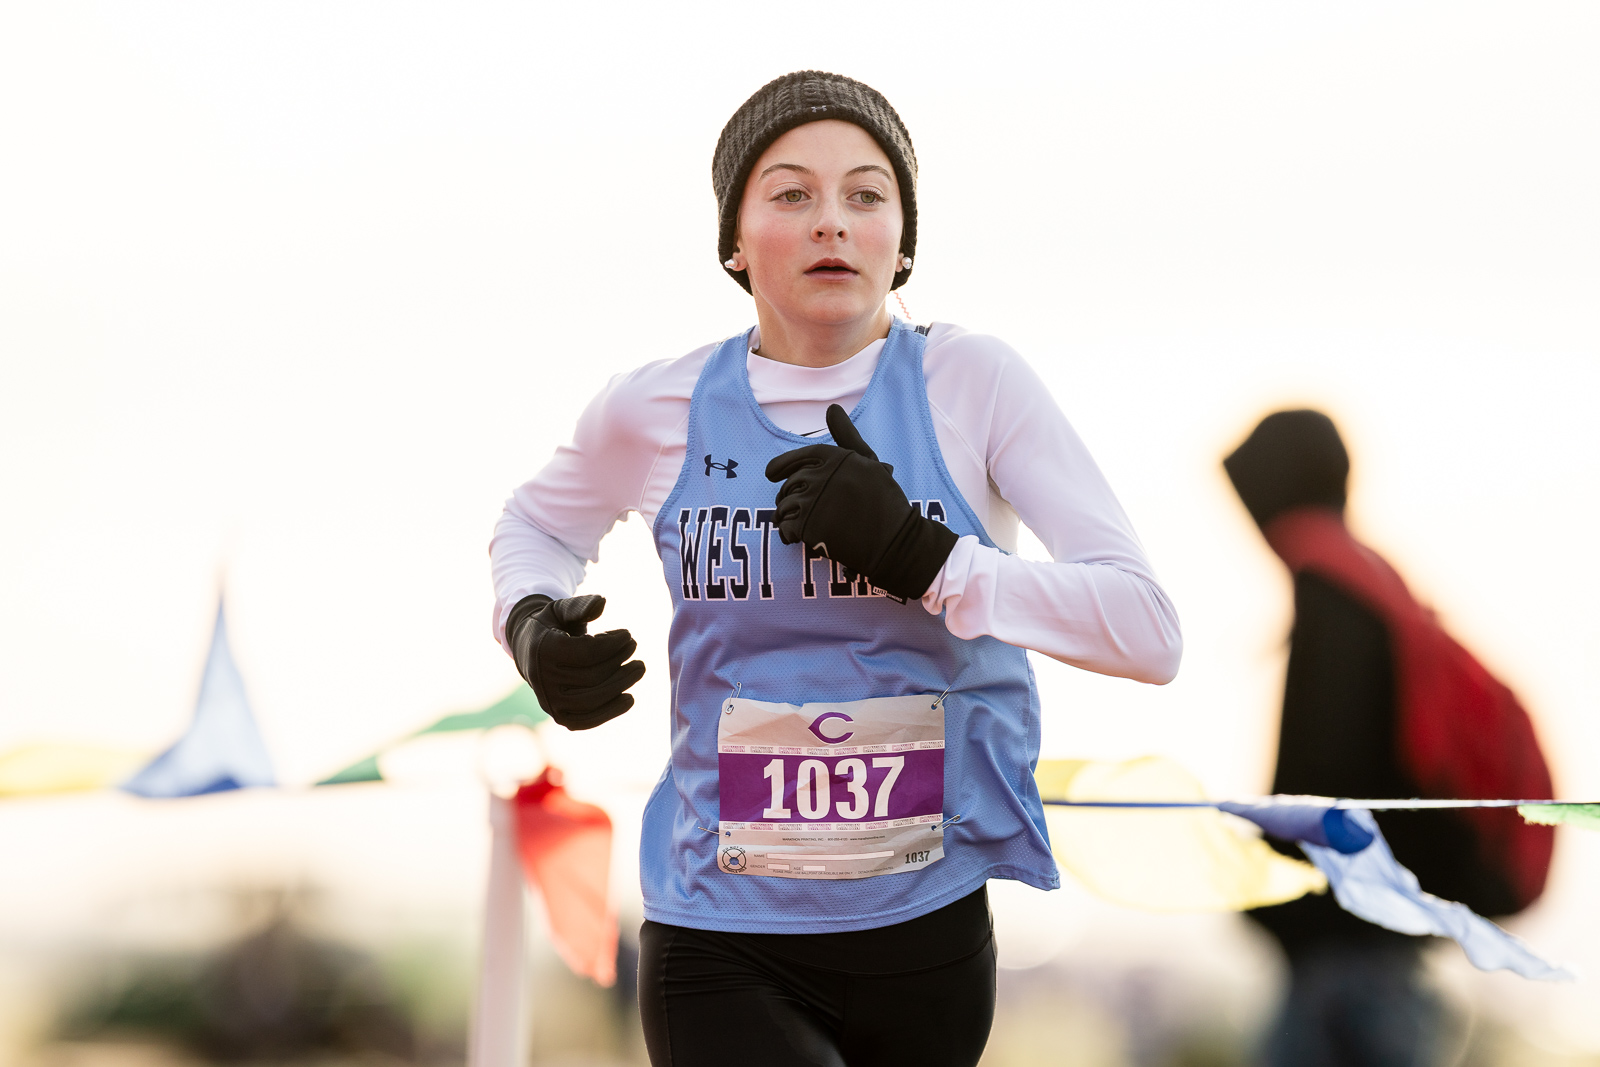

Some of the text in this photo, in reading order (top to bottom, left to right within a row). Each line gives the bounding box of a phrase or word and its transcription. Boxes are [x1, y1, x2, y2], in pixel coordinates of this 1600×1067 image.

[678, 505, 780, 601] WEST
[808, 712, 854, 745] C
[762, 756, 904, 820] 1037
[905, 850, 930, 864] 1037
